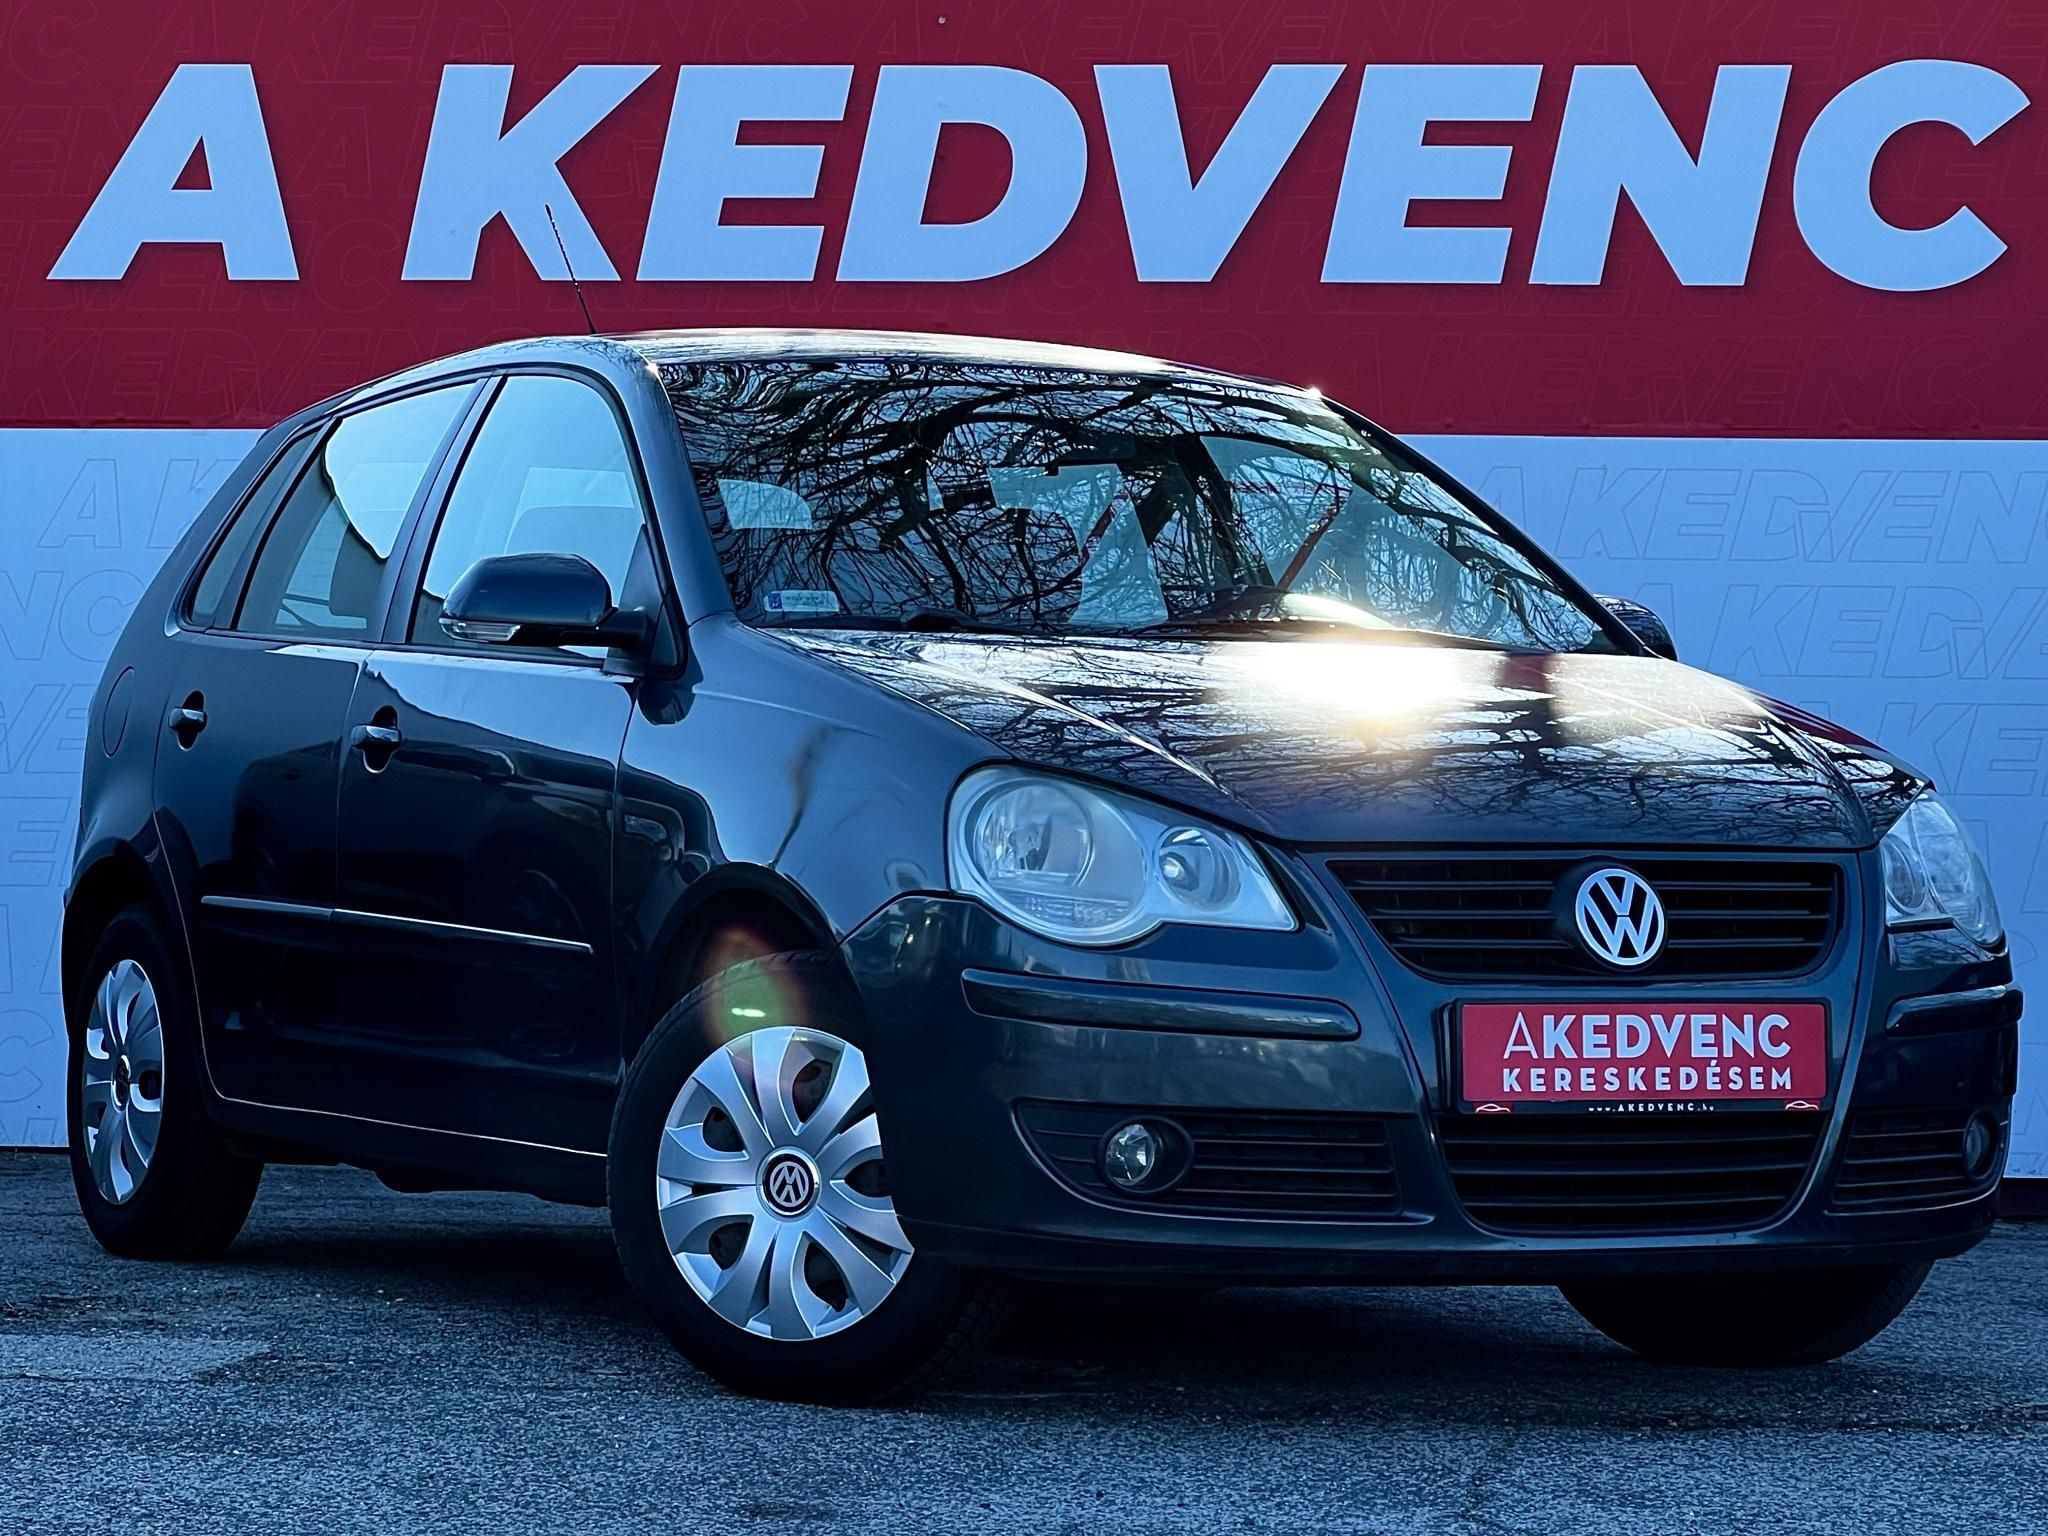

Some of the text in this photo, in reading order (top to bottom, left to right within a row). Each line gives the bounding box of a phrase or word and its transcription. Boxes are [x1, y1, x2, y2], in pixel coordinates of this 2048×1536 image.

[46, 63, 300, 281] A
[400, 58, 2031, 292] KEDVENC
[1503, 1060, 1793, 1093] KERESKEDÉSEM
